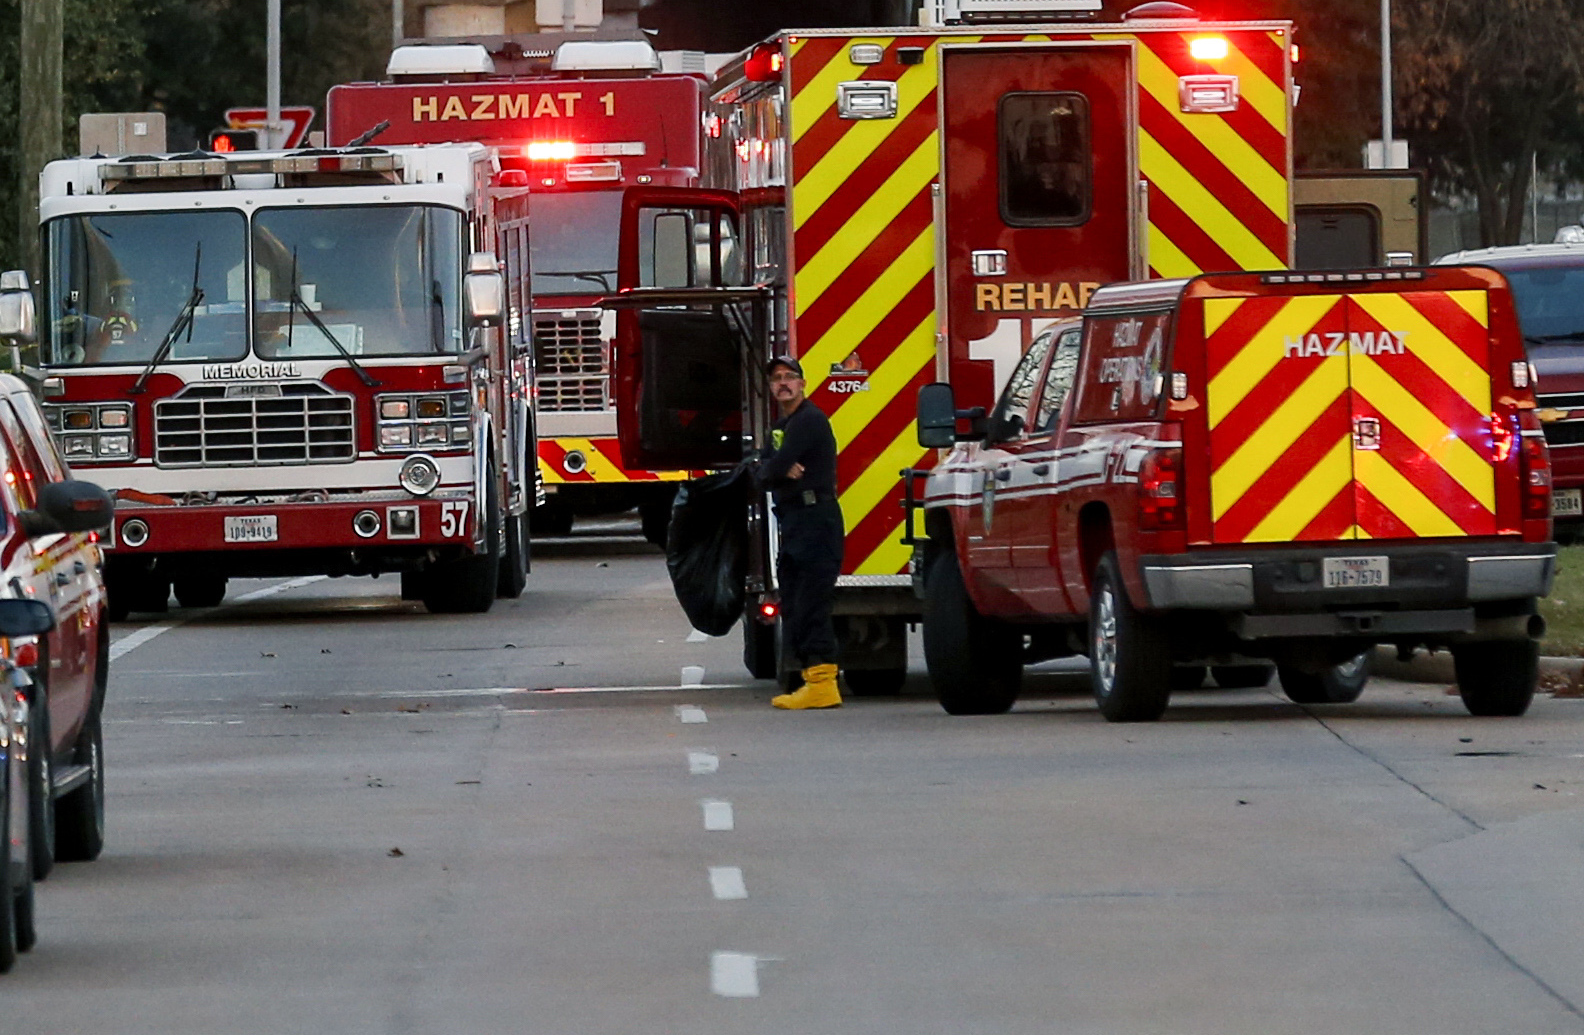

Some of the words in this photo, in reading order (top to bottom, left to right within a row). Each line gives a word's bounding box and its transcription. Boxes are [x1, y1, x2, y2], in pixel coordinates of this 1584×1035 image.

[412, 92, 582, 122] HAZMAT
[599, 91, 615, 117] 1
[203, 363, 302, 380] MEMORIAL
[828, 380, 871, 393] 43764
[440, 501, 469, 537] 57
